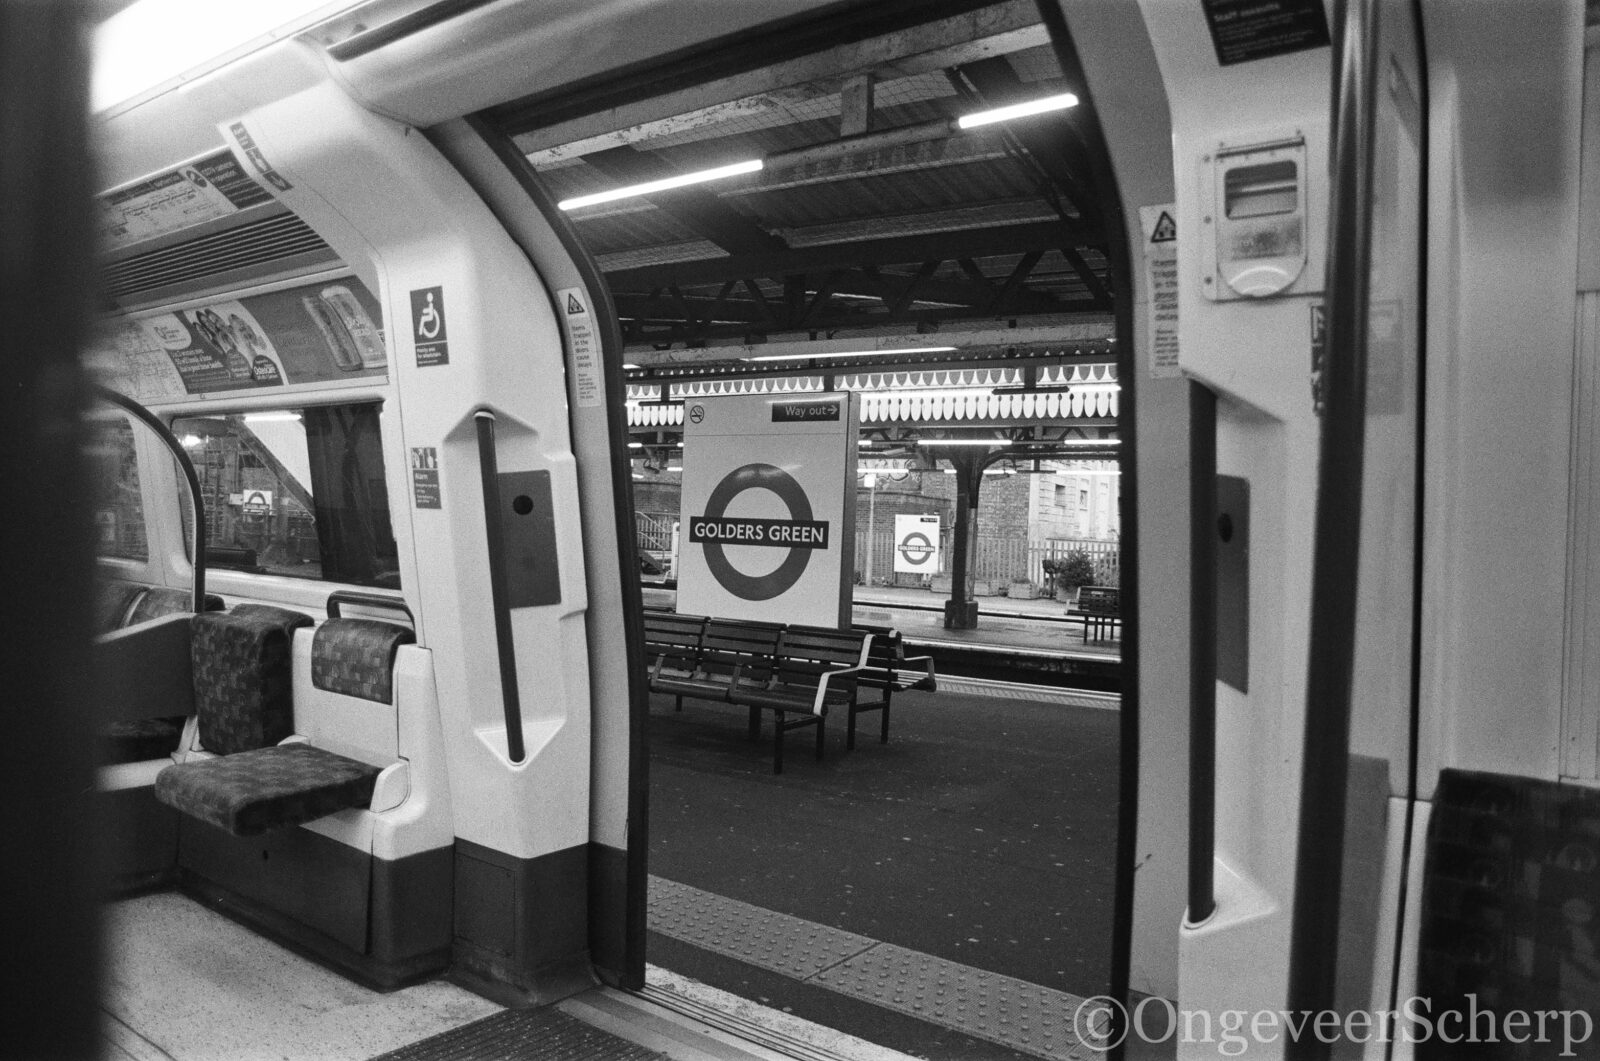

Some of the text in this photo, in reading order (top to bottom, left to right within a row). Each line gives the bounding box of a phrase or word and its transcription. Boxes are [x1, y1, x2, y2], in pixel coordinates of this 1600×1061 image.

[785, 405, 827, 418] Way out
[694, 522, 824, 543] GOLDERS GREEN
